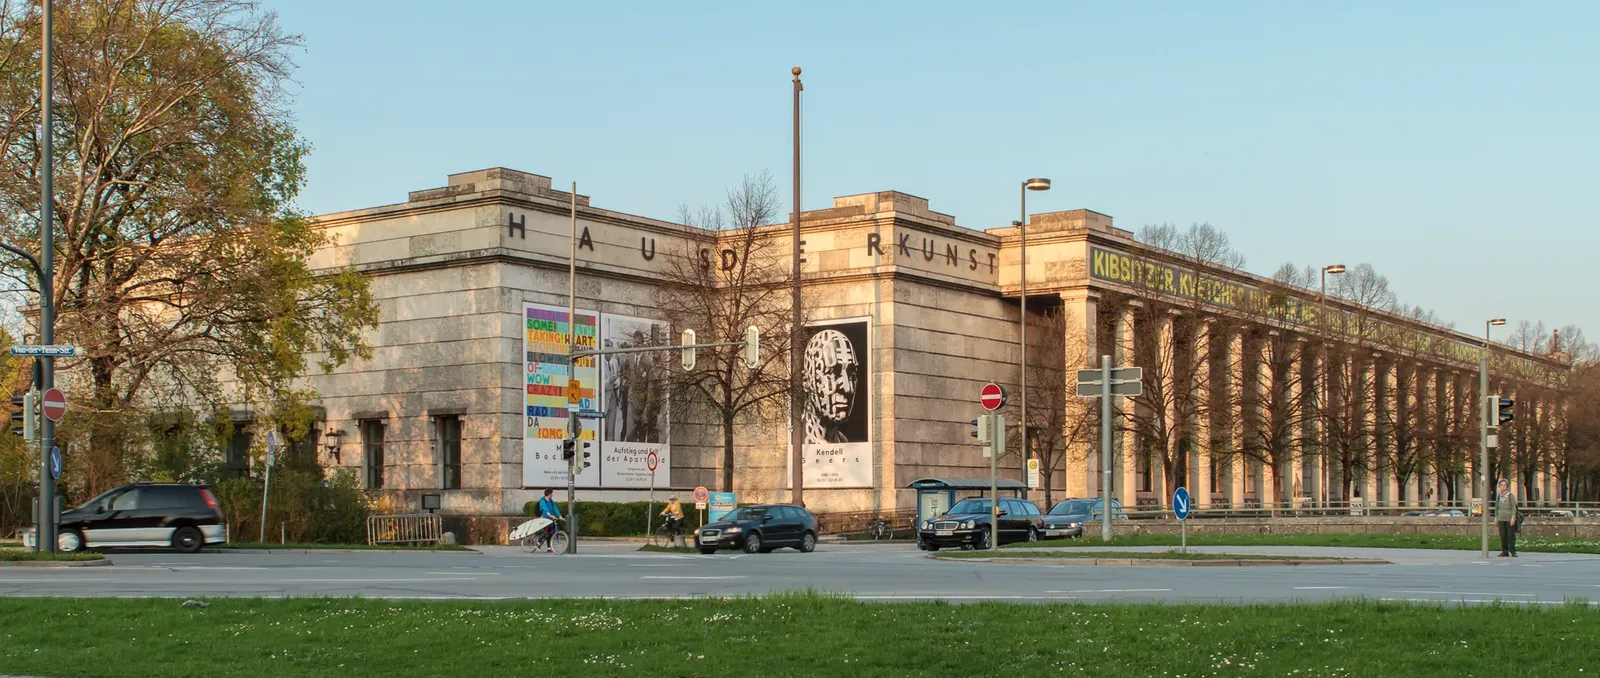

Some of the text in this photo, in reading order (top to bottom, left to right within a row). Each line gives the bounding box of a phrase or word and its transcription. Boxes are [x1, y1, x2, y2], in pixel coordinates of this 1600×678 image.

[509, 212, 711, 271] HAUS
[900, 233, 996, 274] KUNST
[565, 334, 596, 347] HART-
[614, 447, 637, 456] Aufstieg
[816, 448, 843, 456] Kendell
[623, 456, 666, 464] Apartid
